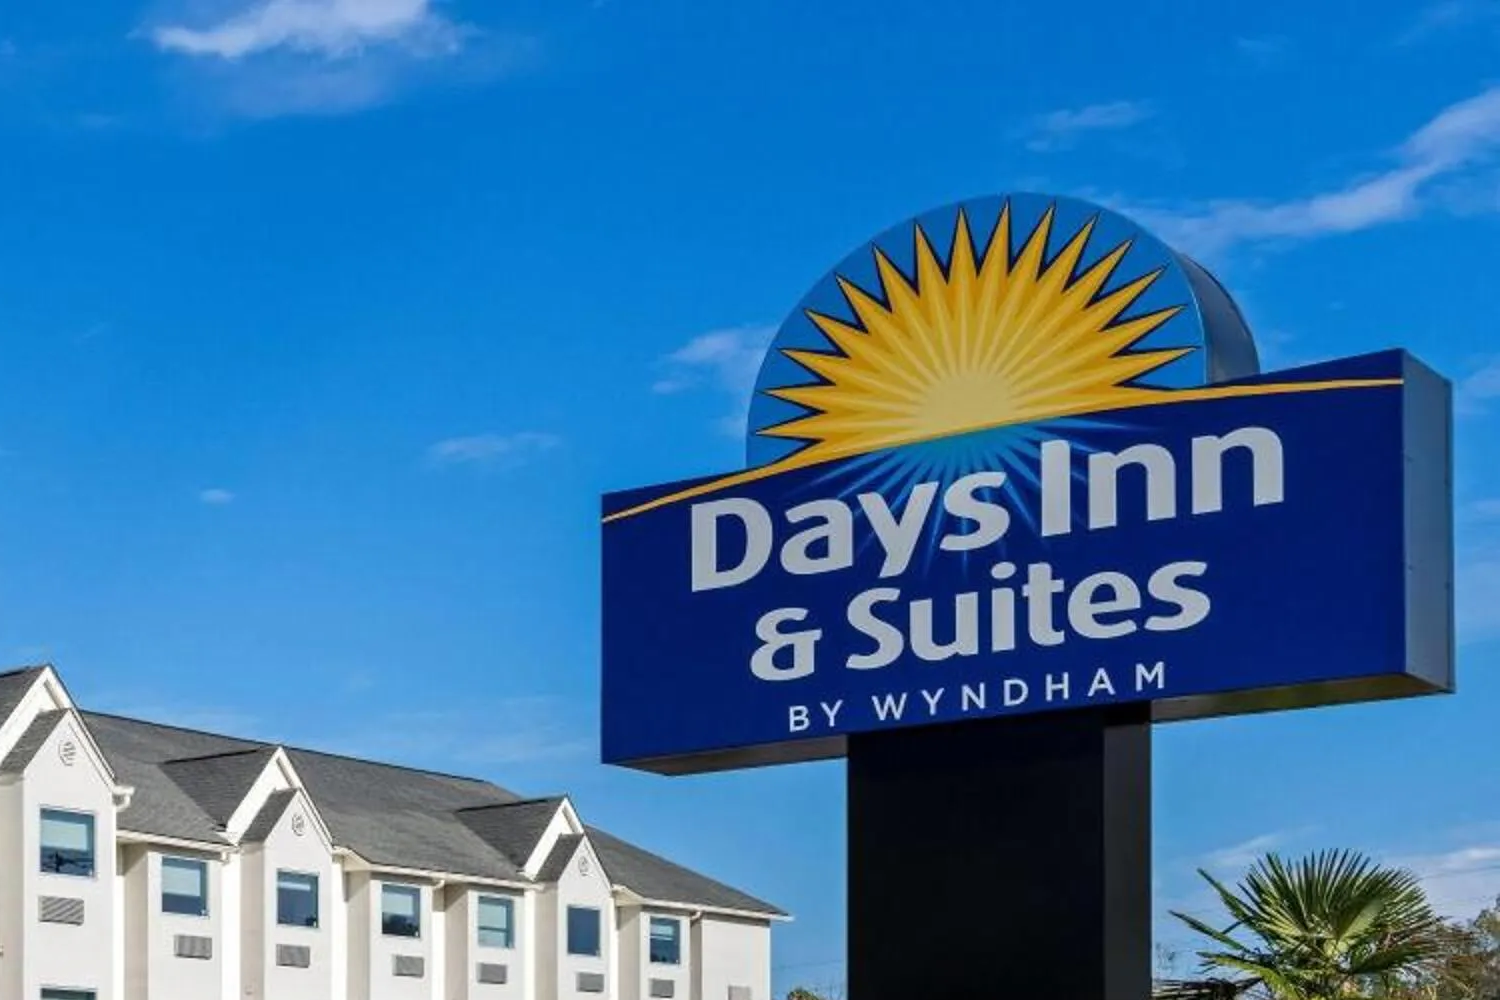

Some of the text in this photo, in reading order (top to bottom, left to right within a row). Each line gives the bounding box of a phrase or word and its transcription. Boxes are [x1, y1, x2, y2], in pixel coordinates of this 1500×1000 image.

[690, 426, 1284, 592] Days Inn
[750, 560, 1211, 682] & Suites
[789, 661, 1166, 732] BY WYNDHAM
